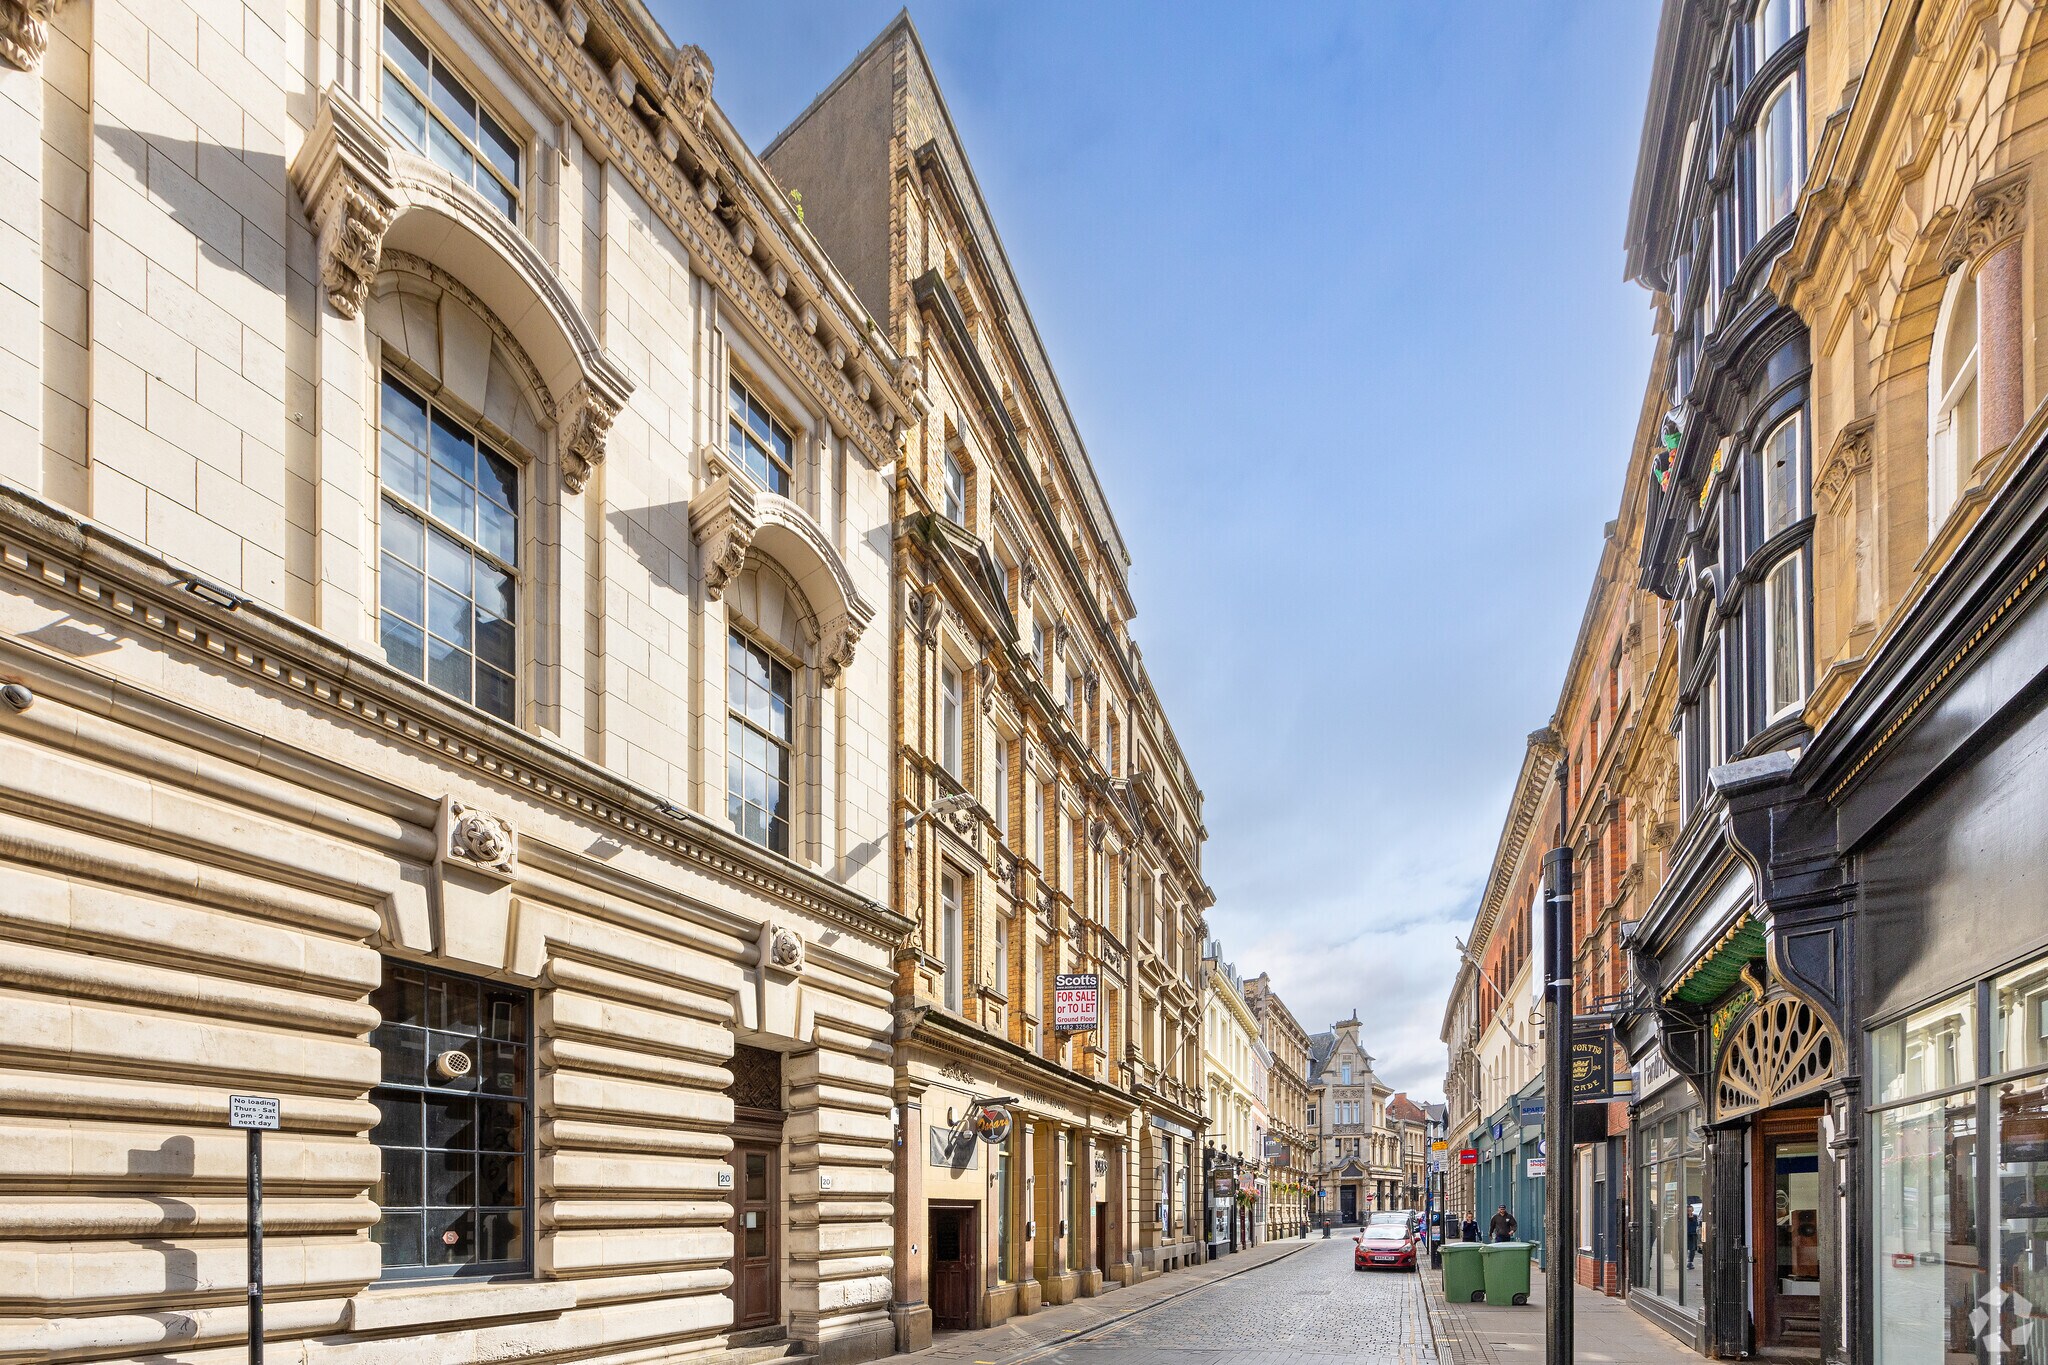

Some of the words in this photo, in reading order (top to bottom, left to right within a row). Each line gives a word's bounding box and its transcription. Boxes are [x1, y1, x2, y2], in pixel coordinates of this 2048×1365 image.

[1056, 975, 1097, 986] Scotts
[1057, 991, 1074, 1002] FOR
[1075, 991, 1096, 1002] SALE
[1057, 1006, 1066, 1014] or
[1067, 1003, 1079, 1013] TO
[1081, 1003, 1096, 1013] LET
[1573, 1080, 1600, 1092] CADE
[248, 1099, 276, 1107] loading
[720, 1174, 731, 1183] 20
[822, 1178, 831, 1186] 20
